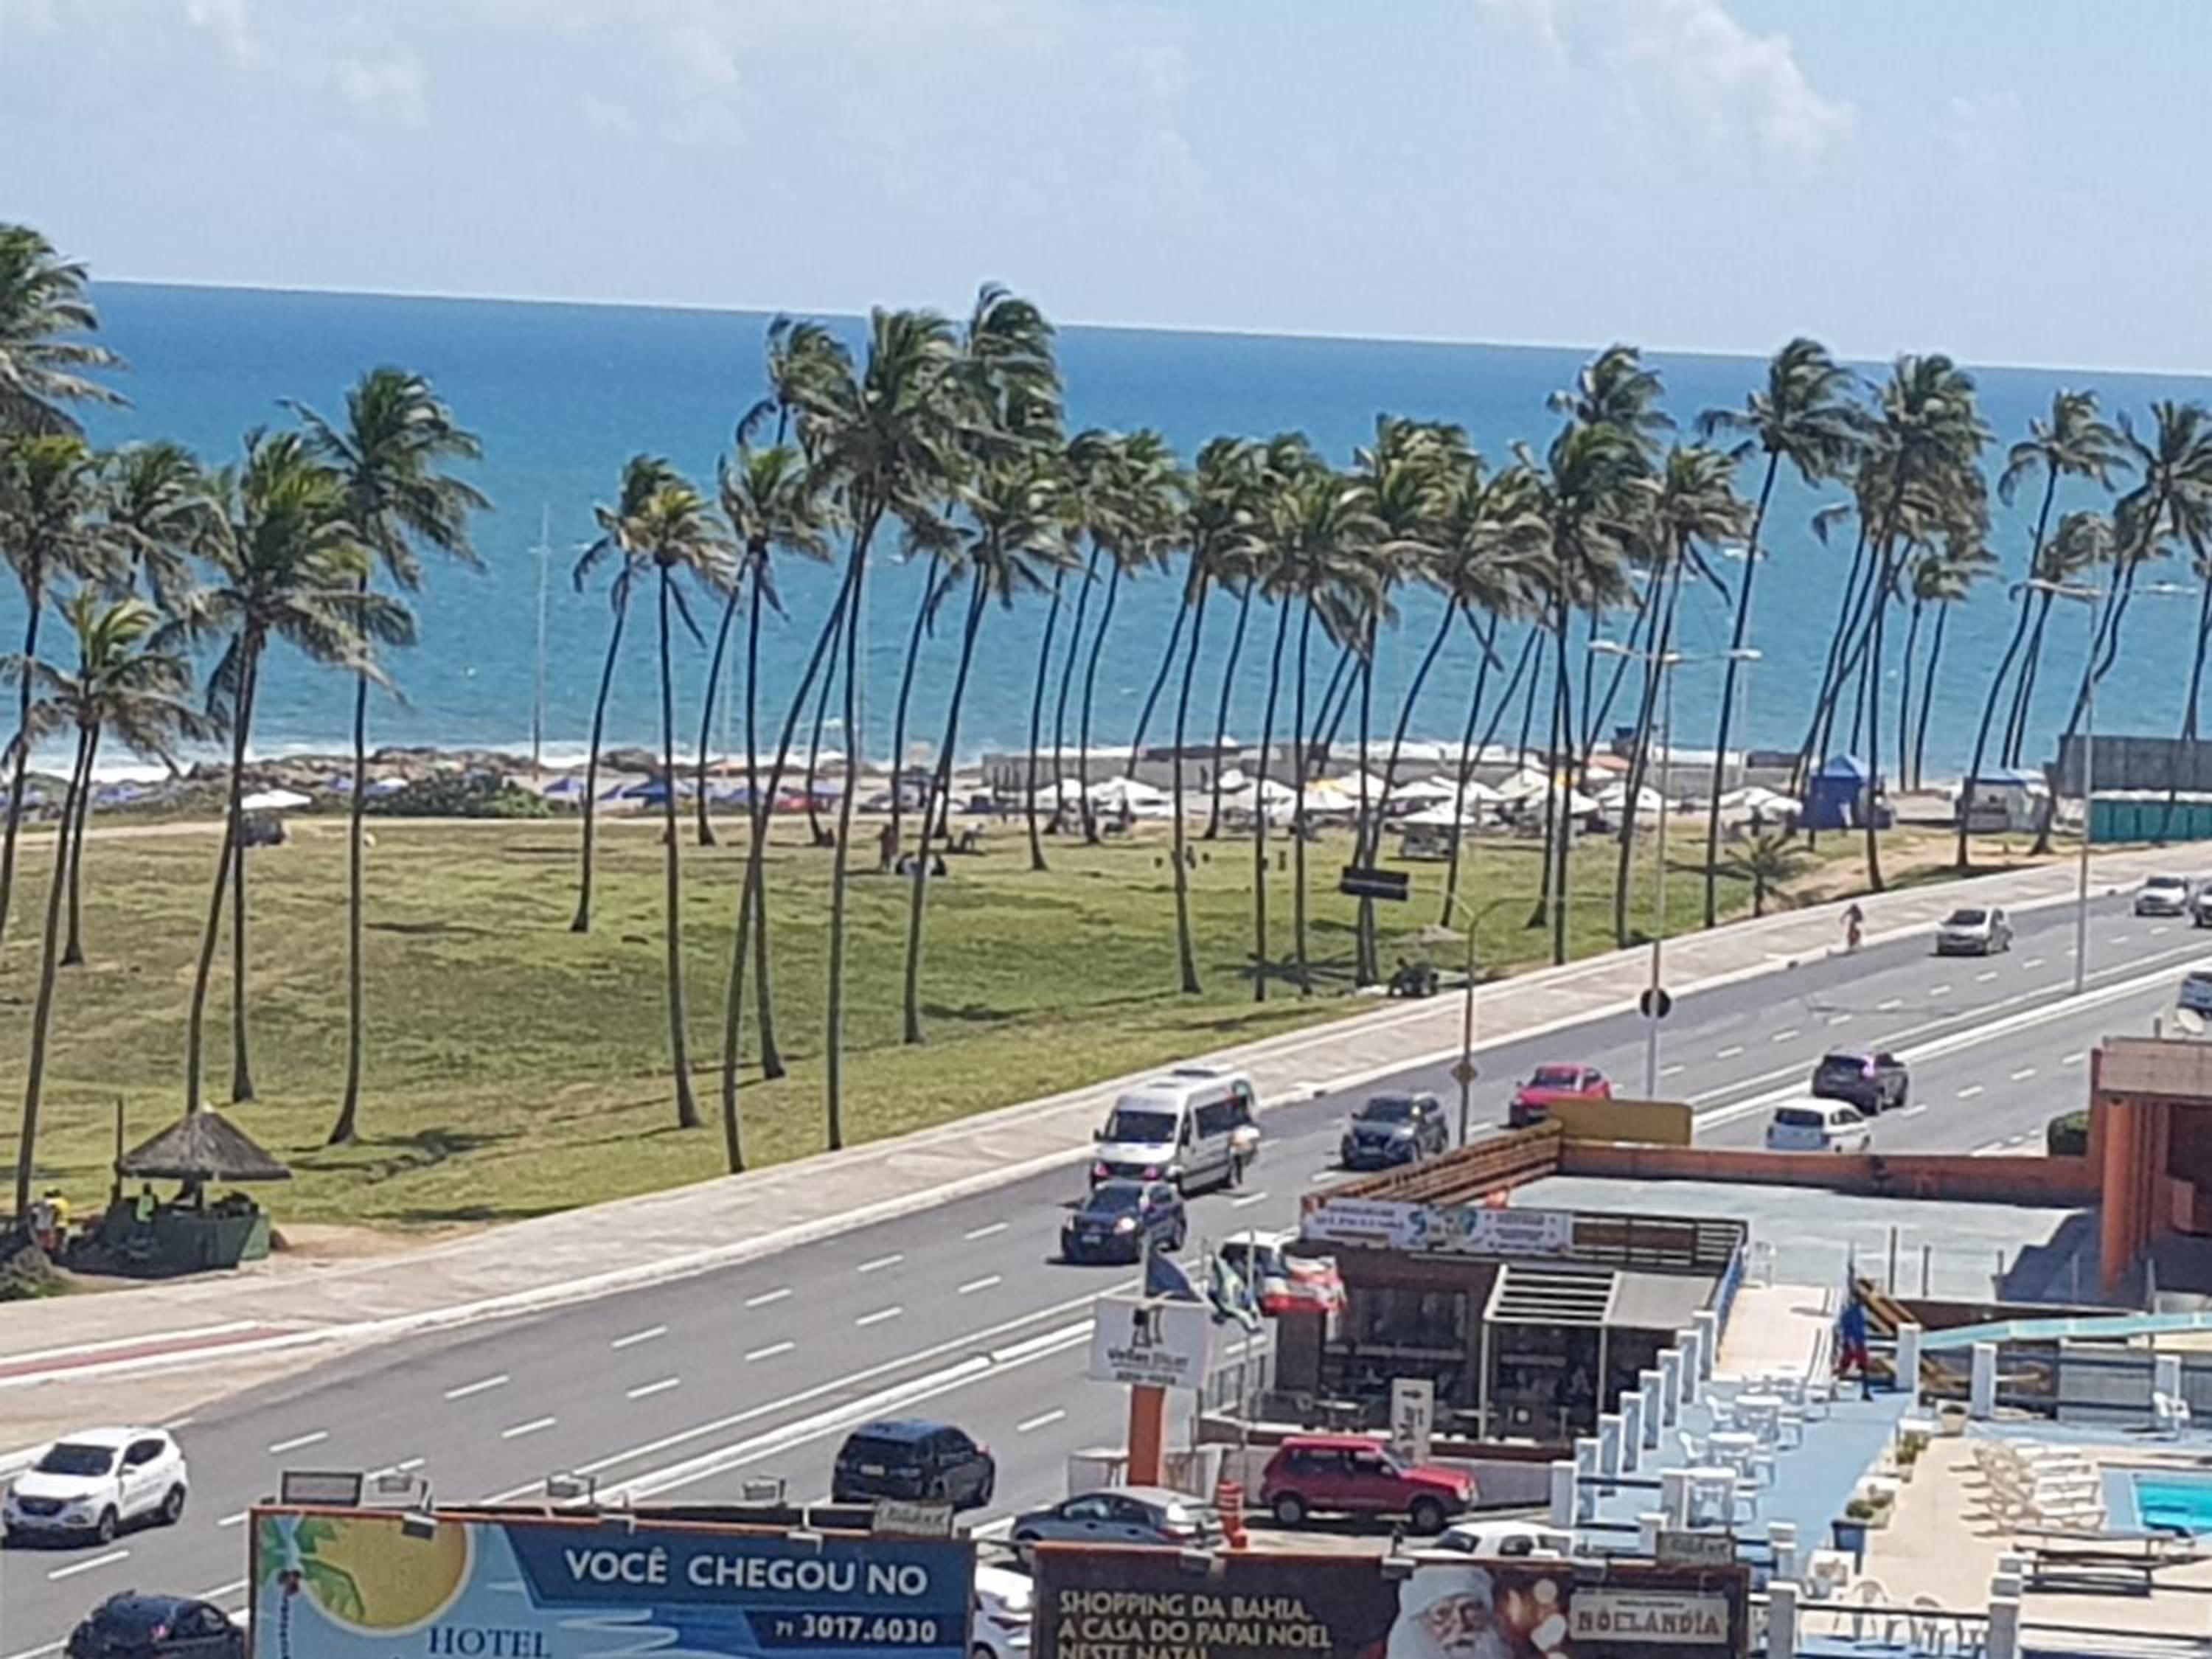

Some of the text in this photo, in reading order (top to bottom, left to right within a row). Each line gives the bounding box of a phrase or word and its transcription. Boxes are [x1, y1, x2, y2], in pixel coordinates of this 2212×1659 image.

[565, 1545, 928, 1596] VOCÊ CHEGOU NO
[1060, 1590, 1185, 1617] SHOPPING
[1192, 1594, 1226, 1618] DA
[428, 1626, 552, 1658] HOTEL
[801, 1613, 937, 1644] 3017.6030
[1057, 1617, 1333, 1648] A CASA DO PAPAI NOEL
